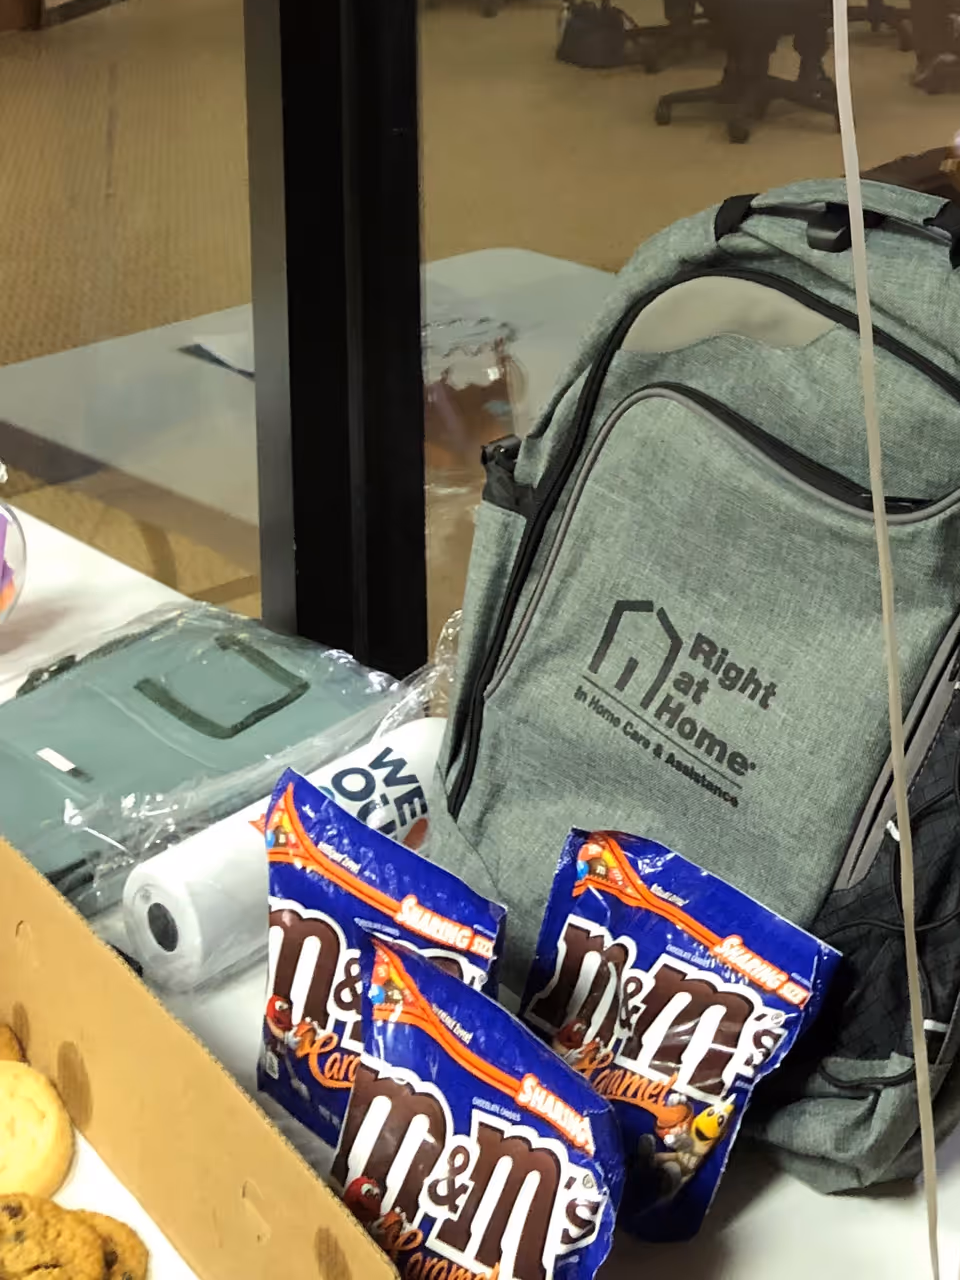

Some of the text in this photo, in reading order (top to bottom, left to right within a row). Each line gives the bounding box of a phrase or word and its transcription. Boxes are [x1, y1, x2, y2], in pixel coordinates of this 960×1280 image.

[672, 671, 709, 705] at
[688, 632, 777, 710] Right
[573, 685, 740, 808] In Home Care & Assistance
[654, 693, 750, 776] Home
[331, 767, 398, 840] OU
[368, 746, 428, 827] WE
[396, 896, 474, 950] SHARING
[713, 936, 787, 989] SHARING
[330, 1065, 601, 1280] m&m's
